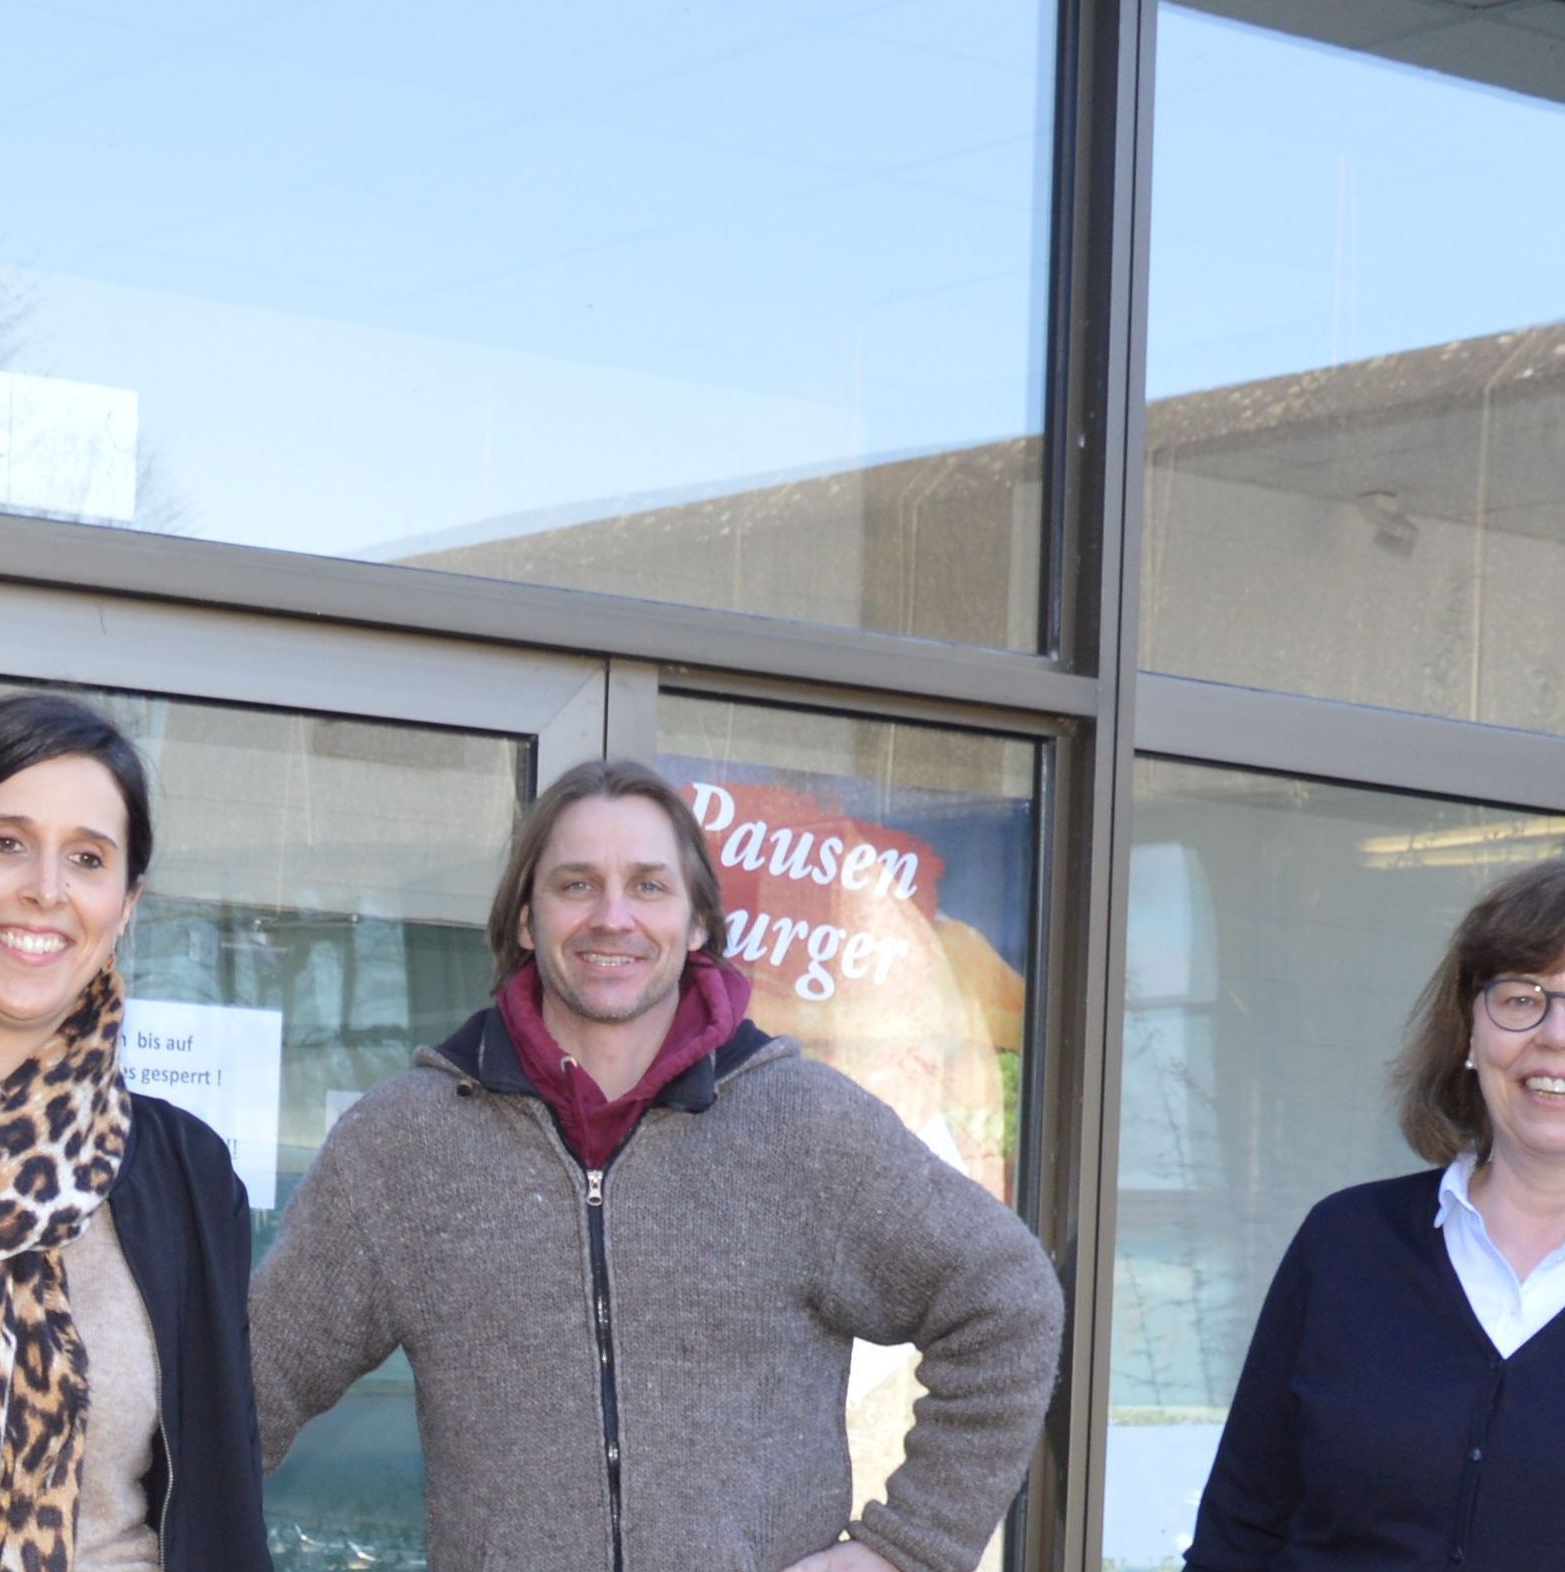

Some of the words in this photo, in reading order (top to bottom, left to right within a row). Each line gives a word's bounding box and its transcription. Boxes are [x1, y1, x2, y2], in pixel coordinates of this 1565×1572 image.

[692, 782, 920, 900] Pausen
[724, 908, 909, 1002] urger
[137, 1031, 161, 1050] bis
[165, 1035, 194, 1052] auf
[141, 1068, 211, 1087] gesperrt
